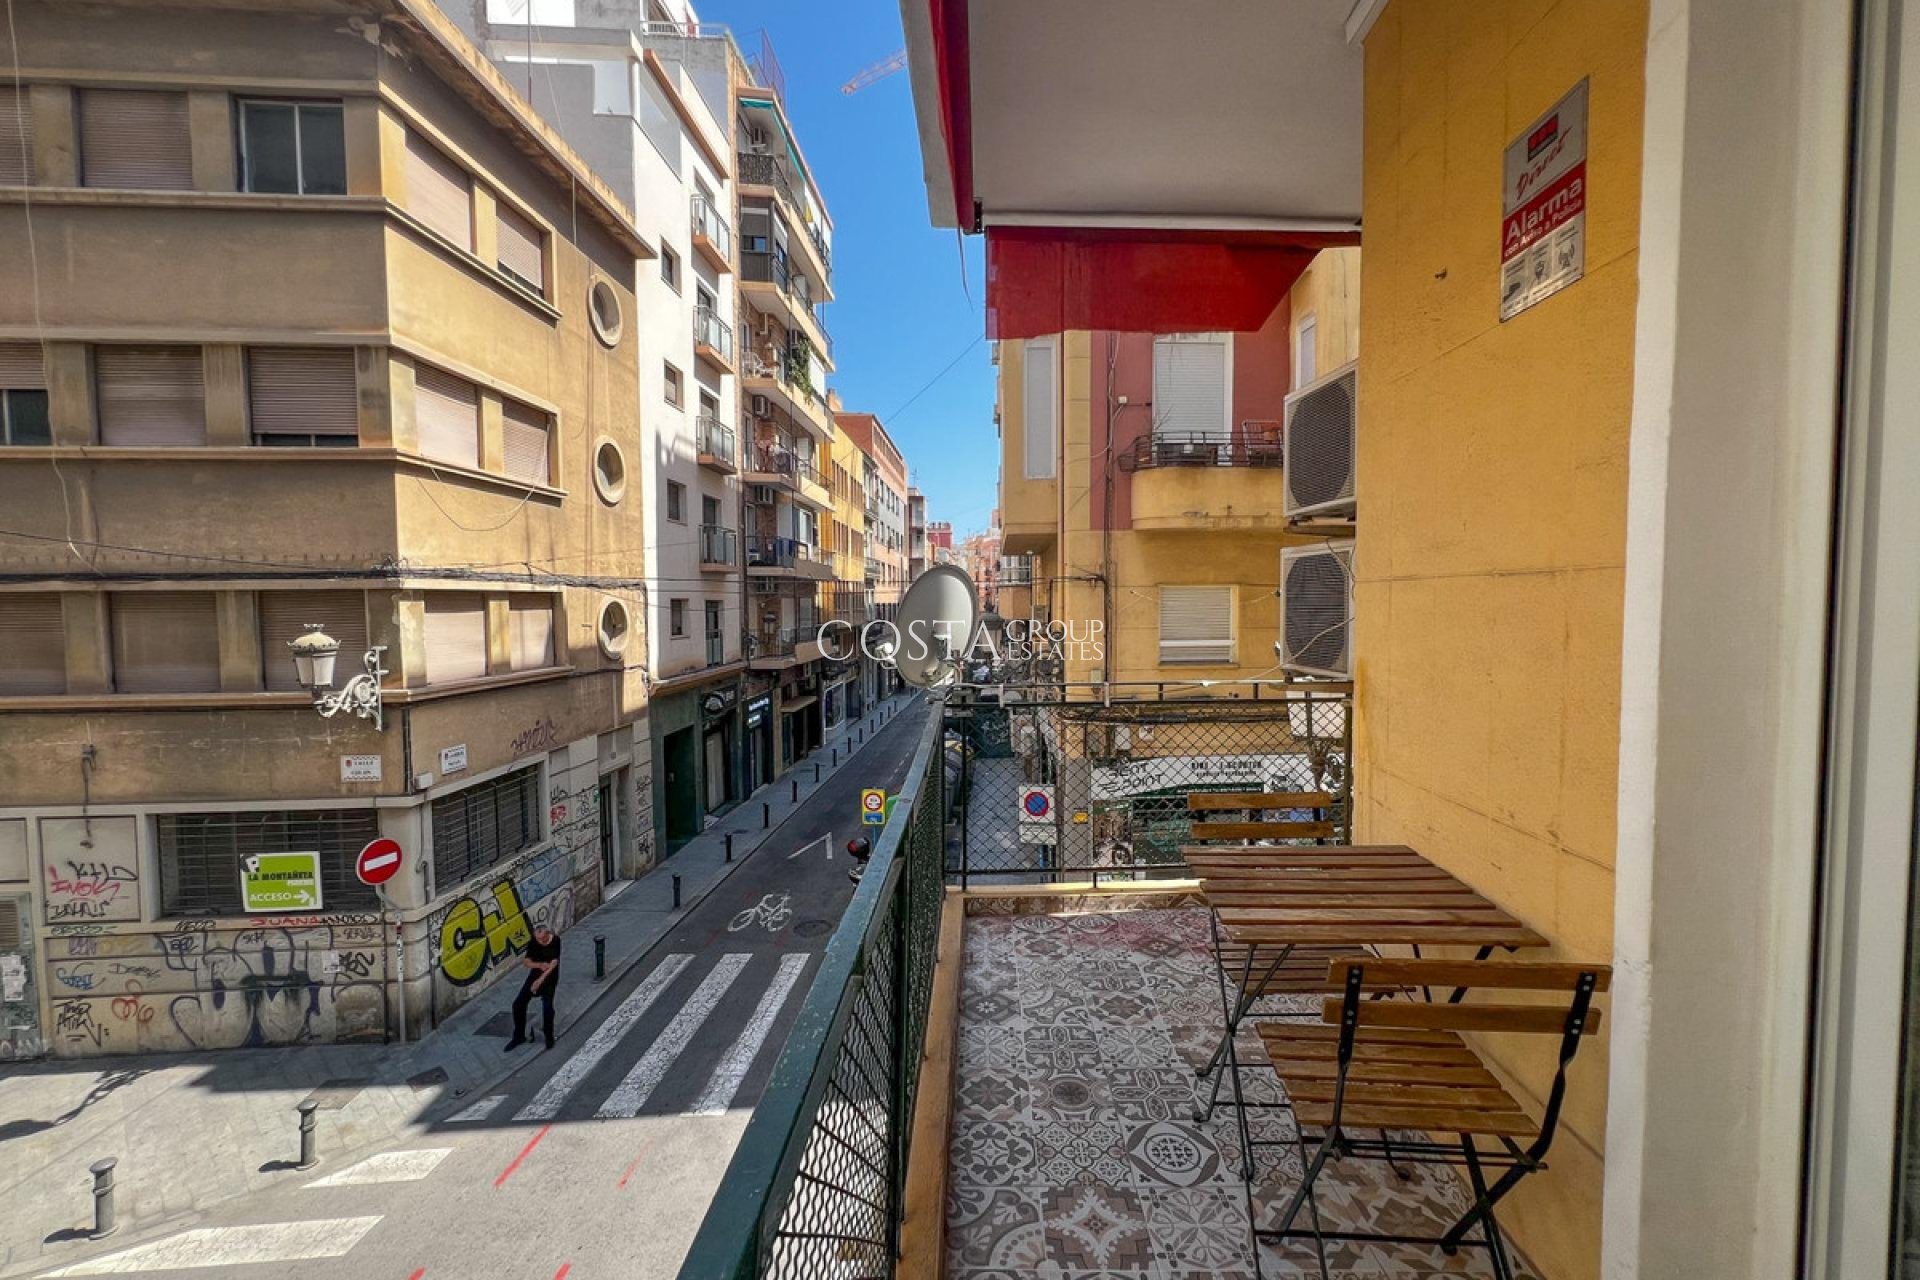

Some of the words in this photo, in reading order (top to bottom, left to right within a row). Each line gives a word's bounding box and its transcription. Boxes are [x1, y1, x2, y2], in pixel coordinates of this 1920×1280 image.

[1504, 177, 1583, 246] Alarma
[247, 873, 259, 881] LA
[261, 870, 314, 881] MONTAÑETA
[249, 892, 292, 902] ACCESO
